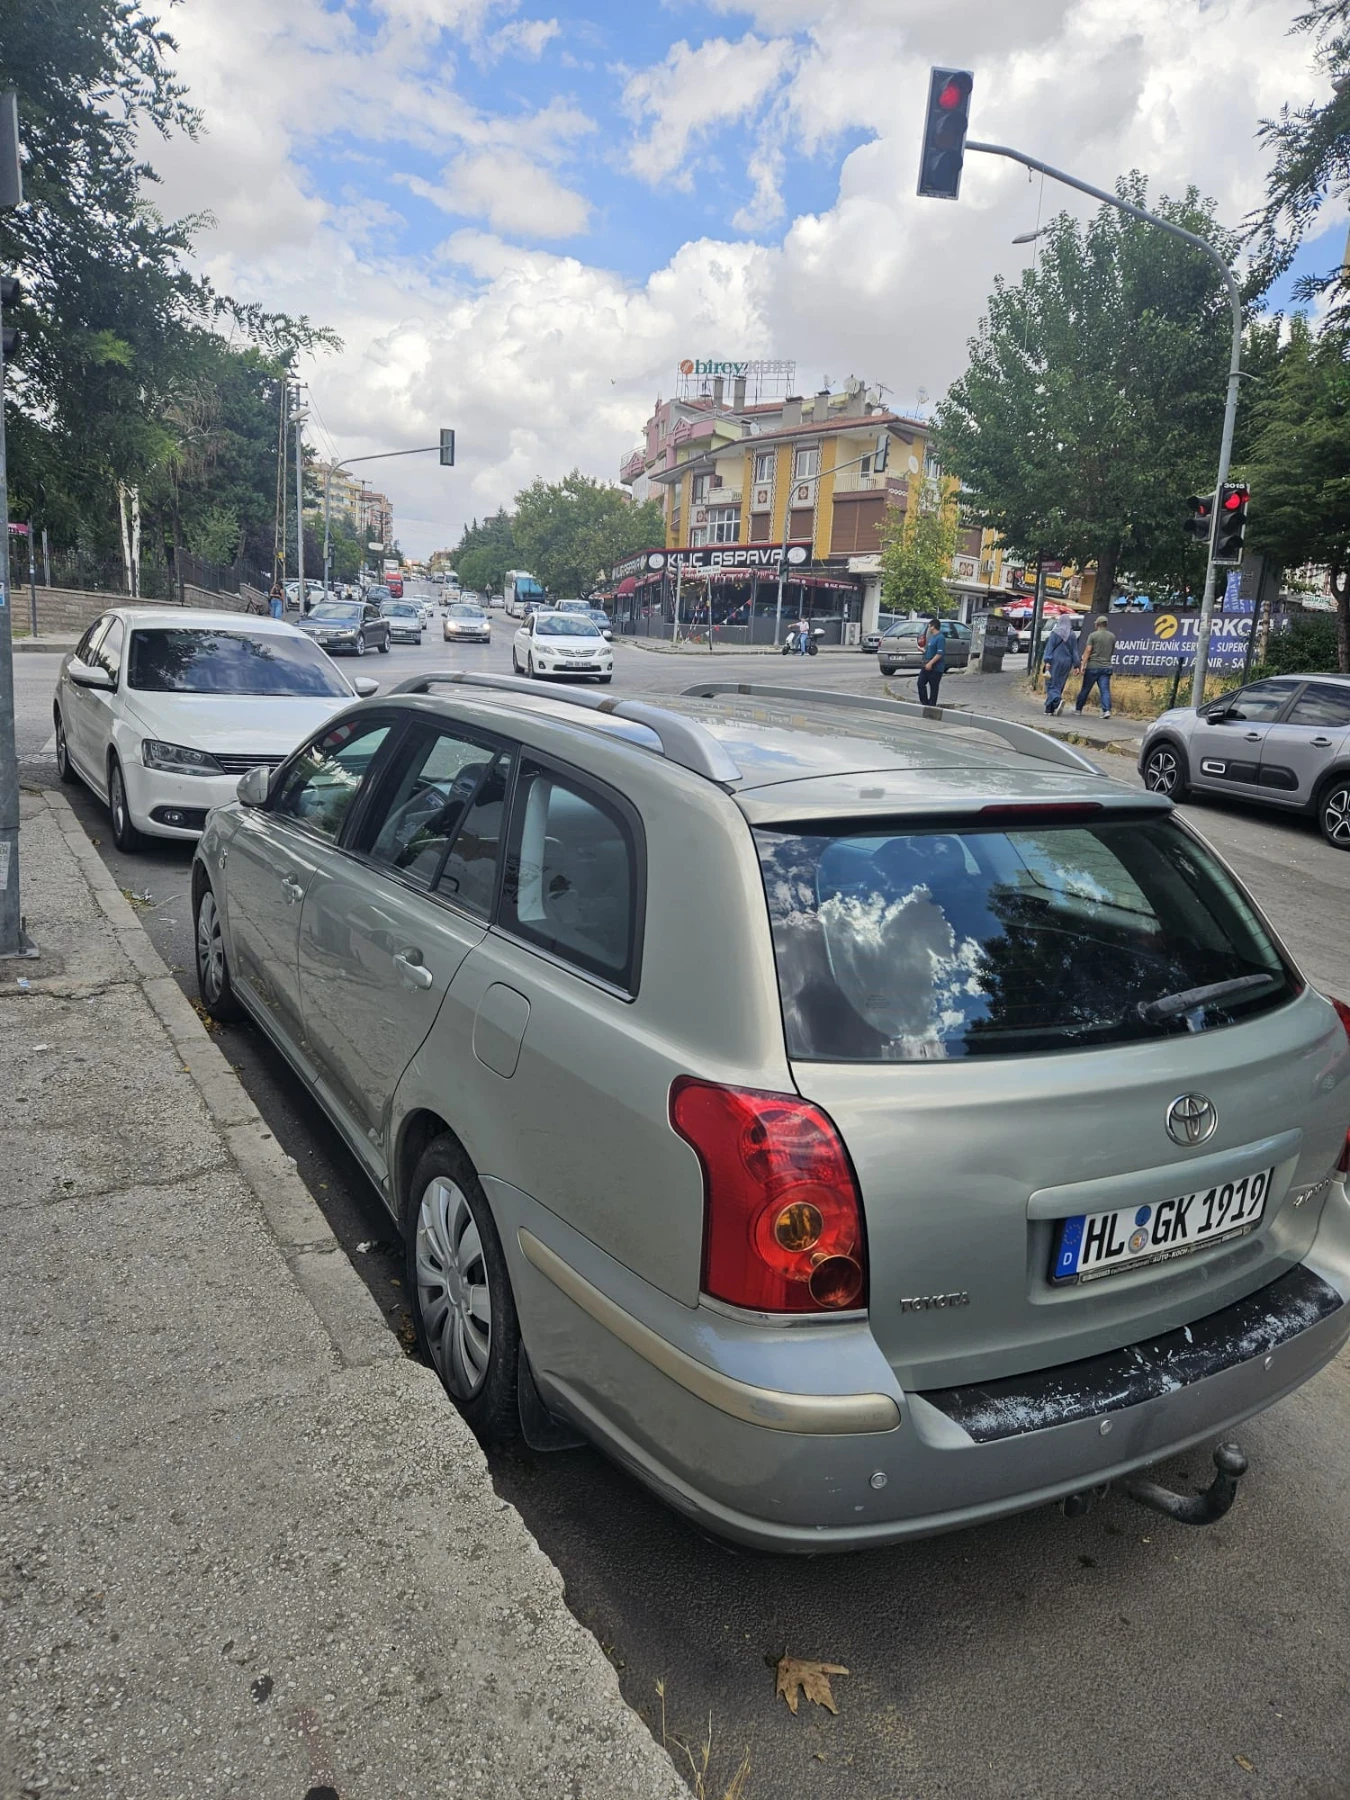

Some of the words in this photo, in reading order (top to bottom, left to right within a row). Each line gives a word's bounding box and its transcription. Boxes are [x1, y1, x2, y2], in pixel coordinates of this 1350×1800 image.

[711, 549, 783, 566] ASPAVA
[1114, 638, 1149, 650] ARANTİLİ
[1151, 639, 1181, 651] TEKNİK
[1122, 655, 1140, 665] CEP
[1083, 1213, 1125, 1264] HL
[1151, 1195, 1196, 1245] GK
[1197, 1173, 1266, 1235] 1919
[1062, 1252, 1073, 1266] D
[900, 1291, 970, 1313] TOYOTA
